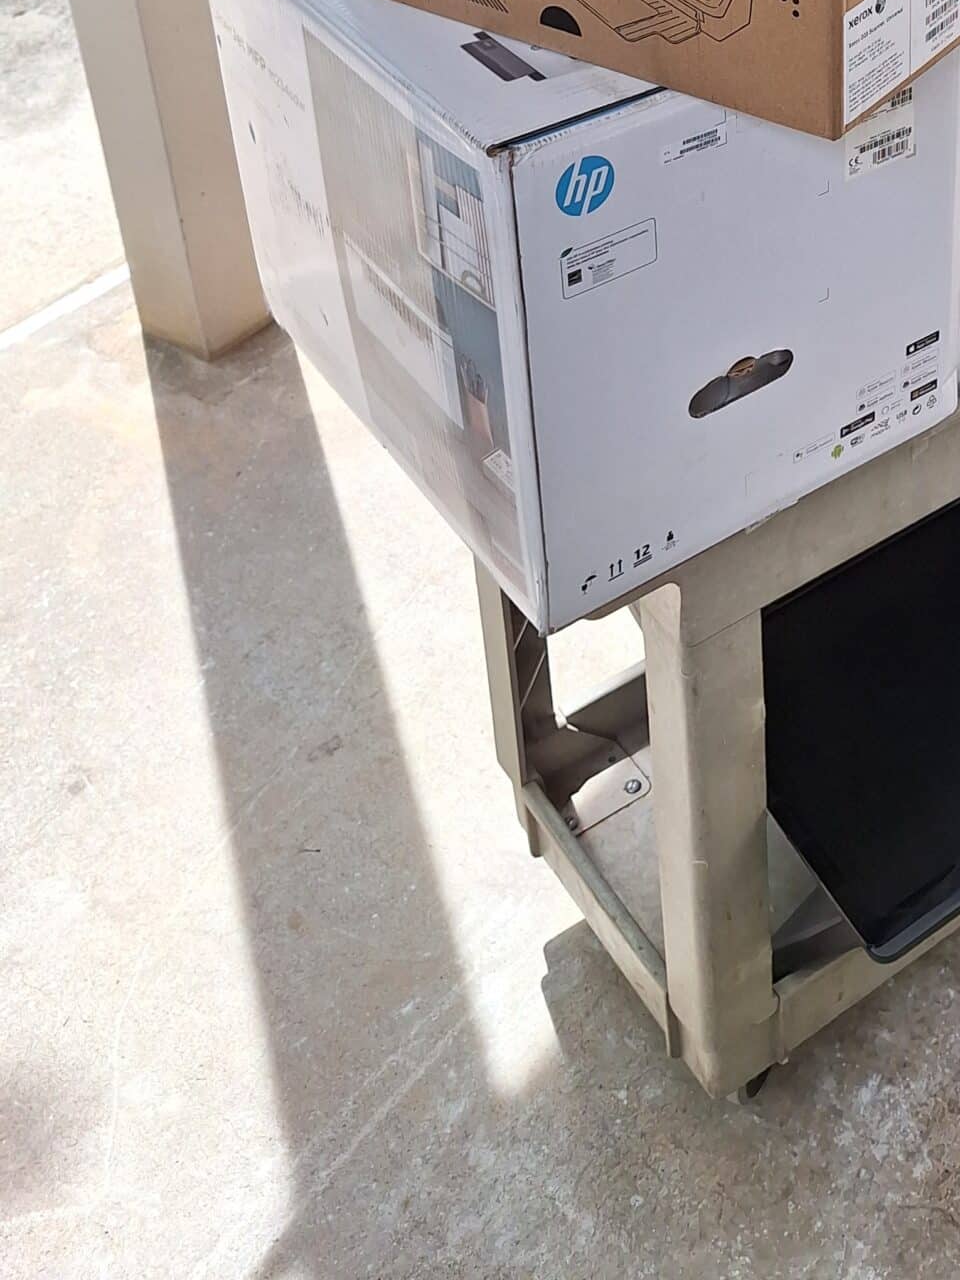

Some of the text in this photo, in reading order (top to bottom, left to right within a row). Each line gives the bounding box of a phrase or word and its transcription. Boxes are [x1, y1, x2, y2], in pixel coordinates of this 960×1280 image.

[848, 6, 873, 30] xerox
[556, 155, 615, 217] hp
[633, 543, 651, 561] 12
